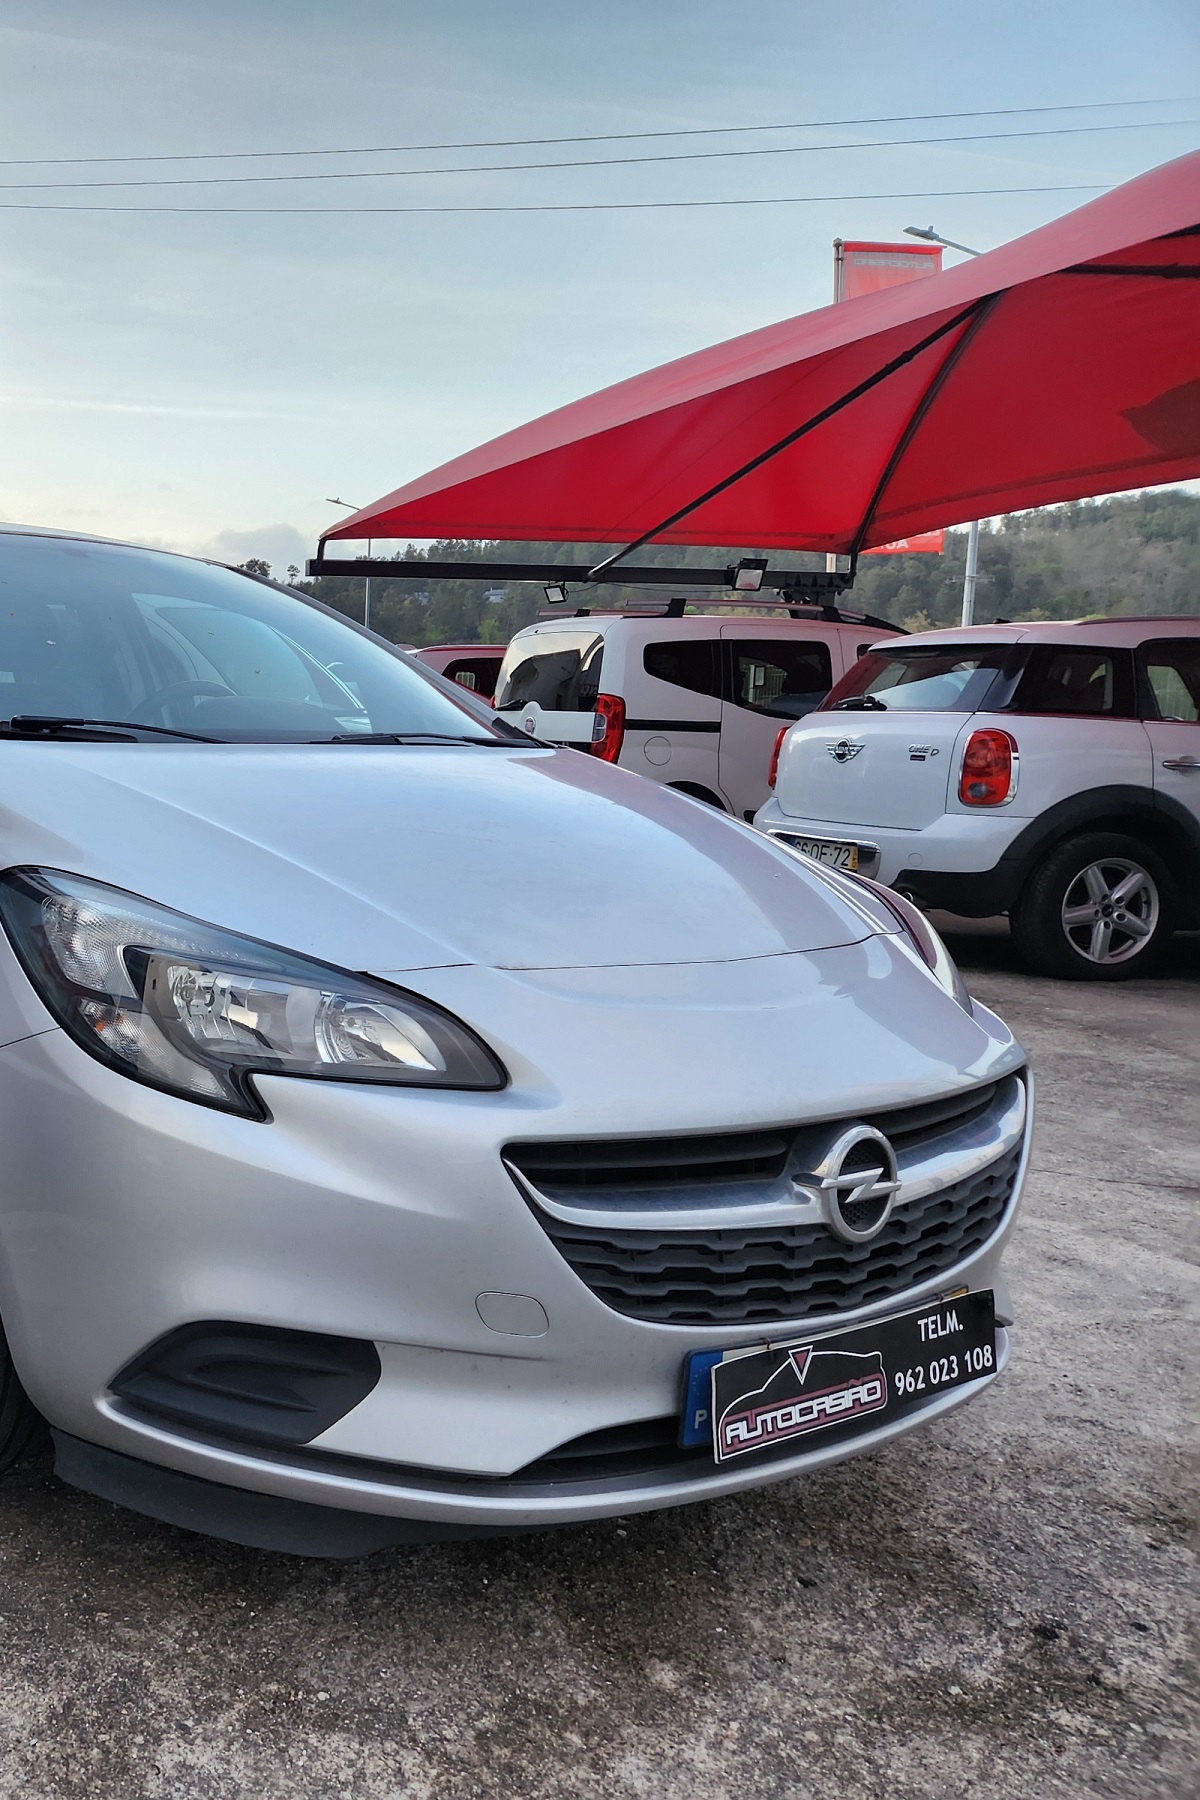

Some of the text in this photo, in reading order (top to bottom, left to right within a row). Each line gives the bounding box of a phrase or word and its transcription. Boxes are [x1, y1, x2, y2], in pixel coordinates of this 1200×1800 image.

[917, 1309, 964, 1342] TELM.
[894, 1344, 993, 1396] 962 023 108
[694, 1409, 708, 1430] P
